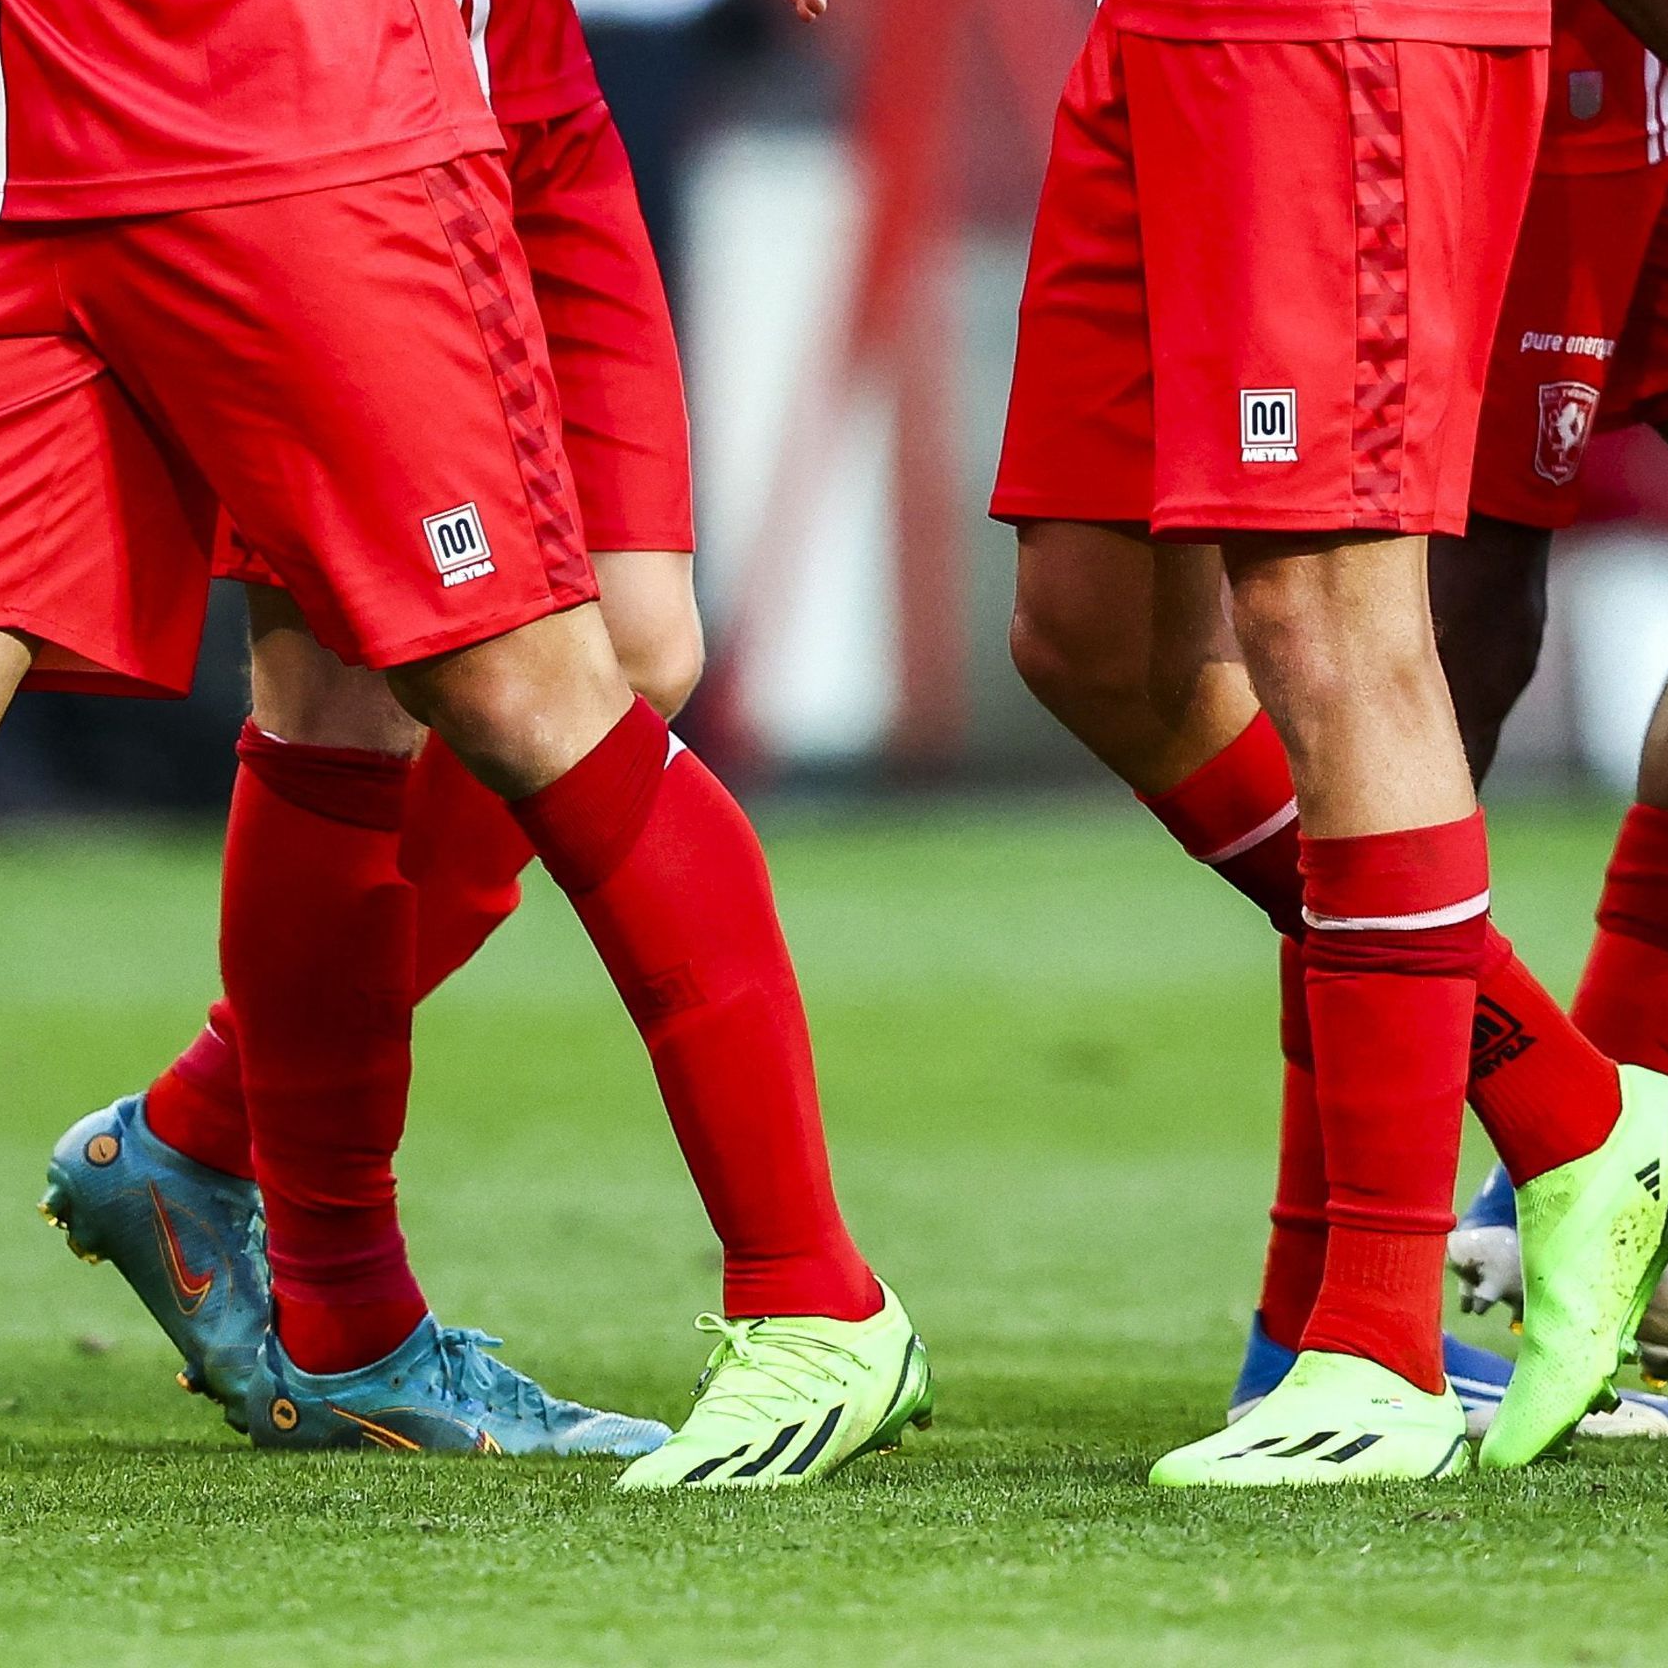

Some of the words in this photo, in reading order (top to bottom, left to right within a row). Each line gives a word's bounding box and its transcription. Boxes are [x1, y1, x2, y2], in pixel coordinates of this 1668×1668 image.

[1520, 331, 1564, 353] pure
[1241, 447, 1299, 462] MEYBA
[442, 559, 496, 588] MEYBA
